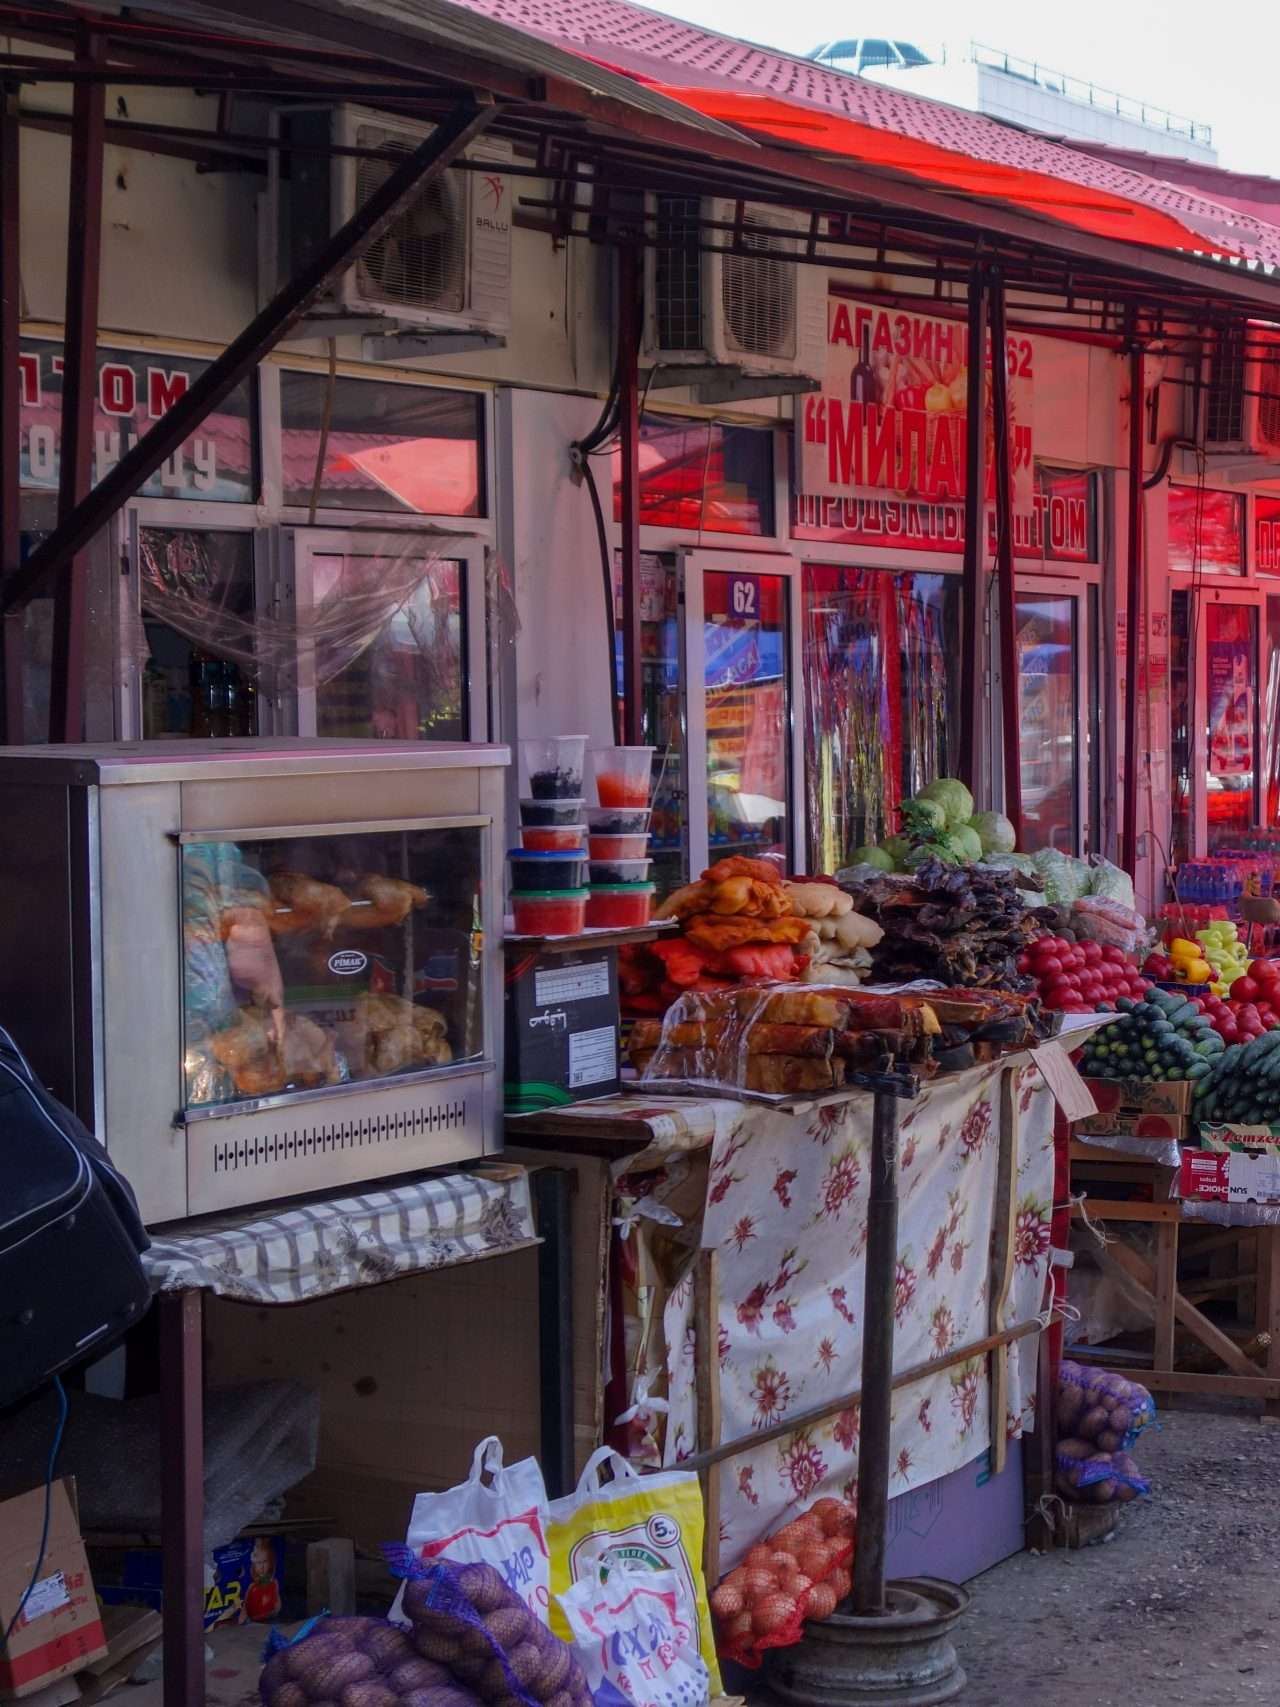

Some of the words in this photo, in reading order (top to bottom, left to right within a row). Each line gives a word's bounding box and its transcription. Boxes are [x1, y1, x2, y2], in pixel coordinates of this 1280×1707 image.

[827, 300, 954, 365] АГАЗИН
[733, 581, 755, 614] 62
[654, 1521, 668, 1538] 5
